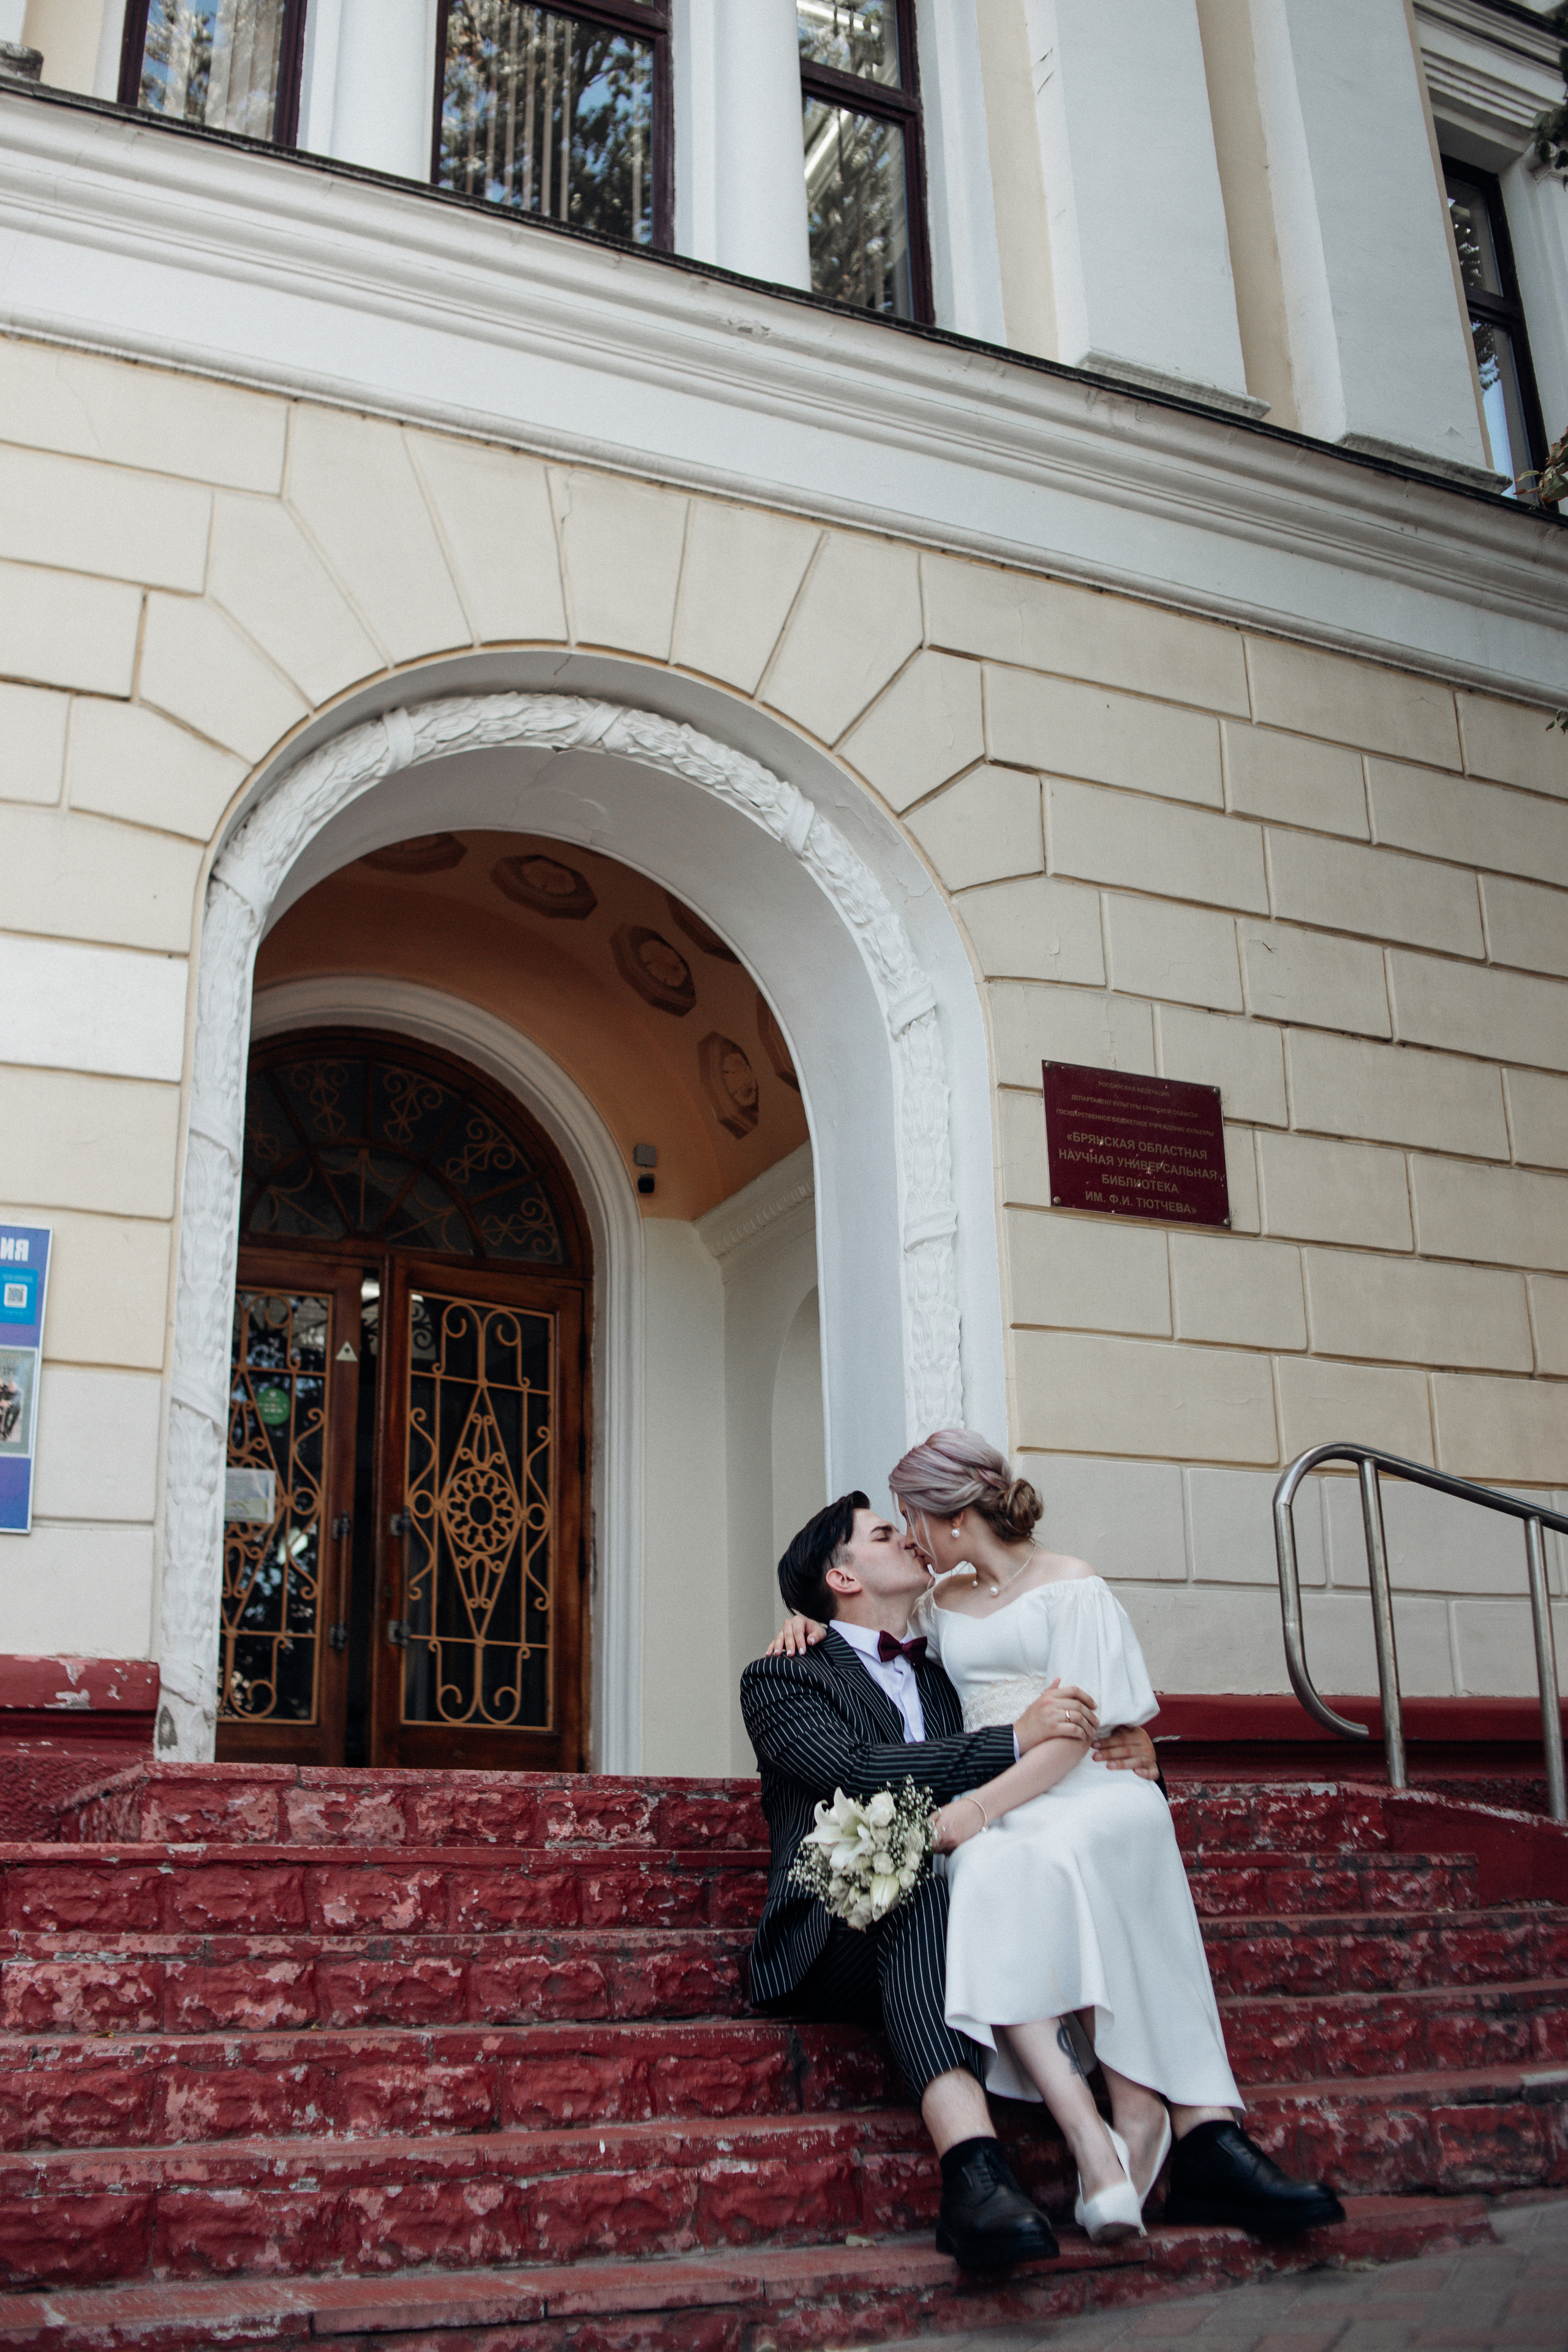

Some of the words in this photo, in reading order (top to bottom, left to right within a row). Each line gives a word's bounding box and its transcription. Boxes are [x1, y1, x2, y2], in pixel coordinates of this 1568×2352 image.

[1098, 1081, 1136, 1091] РОССИЙСКАЯ
[1071, 1095, 1112, 1106] ДЕПАРТАМЕНТ
[1113, 1101, 1141, 1110] КУЛЬТУРЫ
[1172, 1109, 1198, 1118] ОБЛАСТИ
[1056, 1109, 1111, 1121] ГОСУДАРСТВЕННОЕ
[1112, 1117, 1148, 1127] БЮДЖЕТНОЕ
[1148, 1122, 1185, 1133] УЧРЕЖДЕНИЕ
[1186, 1128, 1214, 1137] КУЛЬТУРЫ
[1066, 1132, 1135, 1150] «БРЯНСКАЯ
[1138, 1142, 1207, 1160] ОБЛАСТНАЯ
[1059, 1149, 1114, 1166] НАУЧНАЯ
[1117, 1156, 1217, 1180] УНИВЕРСАЛЬНАЯ
[1102, 1174, 1179, 1194] БИБЛИОТЕКА
[1085, 1191, 1106, 1202] ИМ.
[1109, 1194, 1133, 1206] Ф.И.
[1136, 1197, 1197, 1213] ТЮТЧЕВА»
